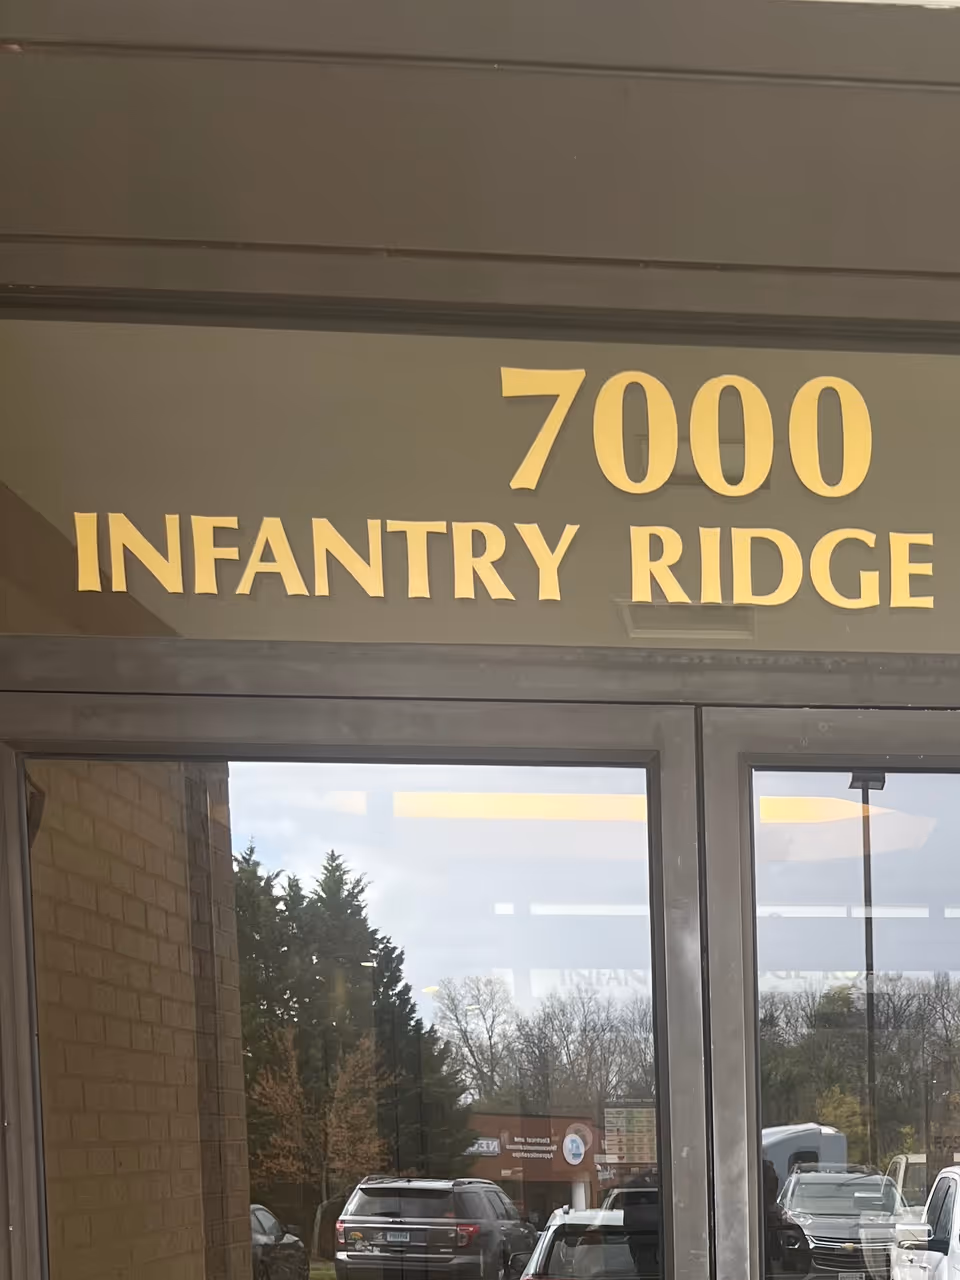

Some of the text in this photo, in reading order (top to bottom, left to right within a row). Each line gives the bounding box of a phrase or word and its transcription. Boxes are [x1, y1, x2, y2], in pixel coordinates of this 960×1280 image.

[500, 366, 873, 498] 7000
[73, 511, 580, 602] INFANTRY
[629, 524, 935, 609] RIDGE
